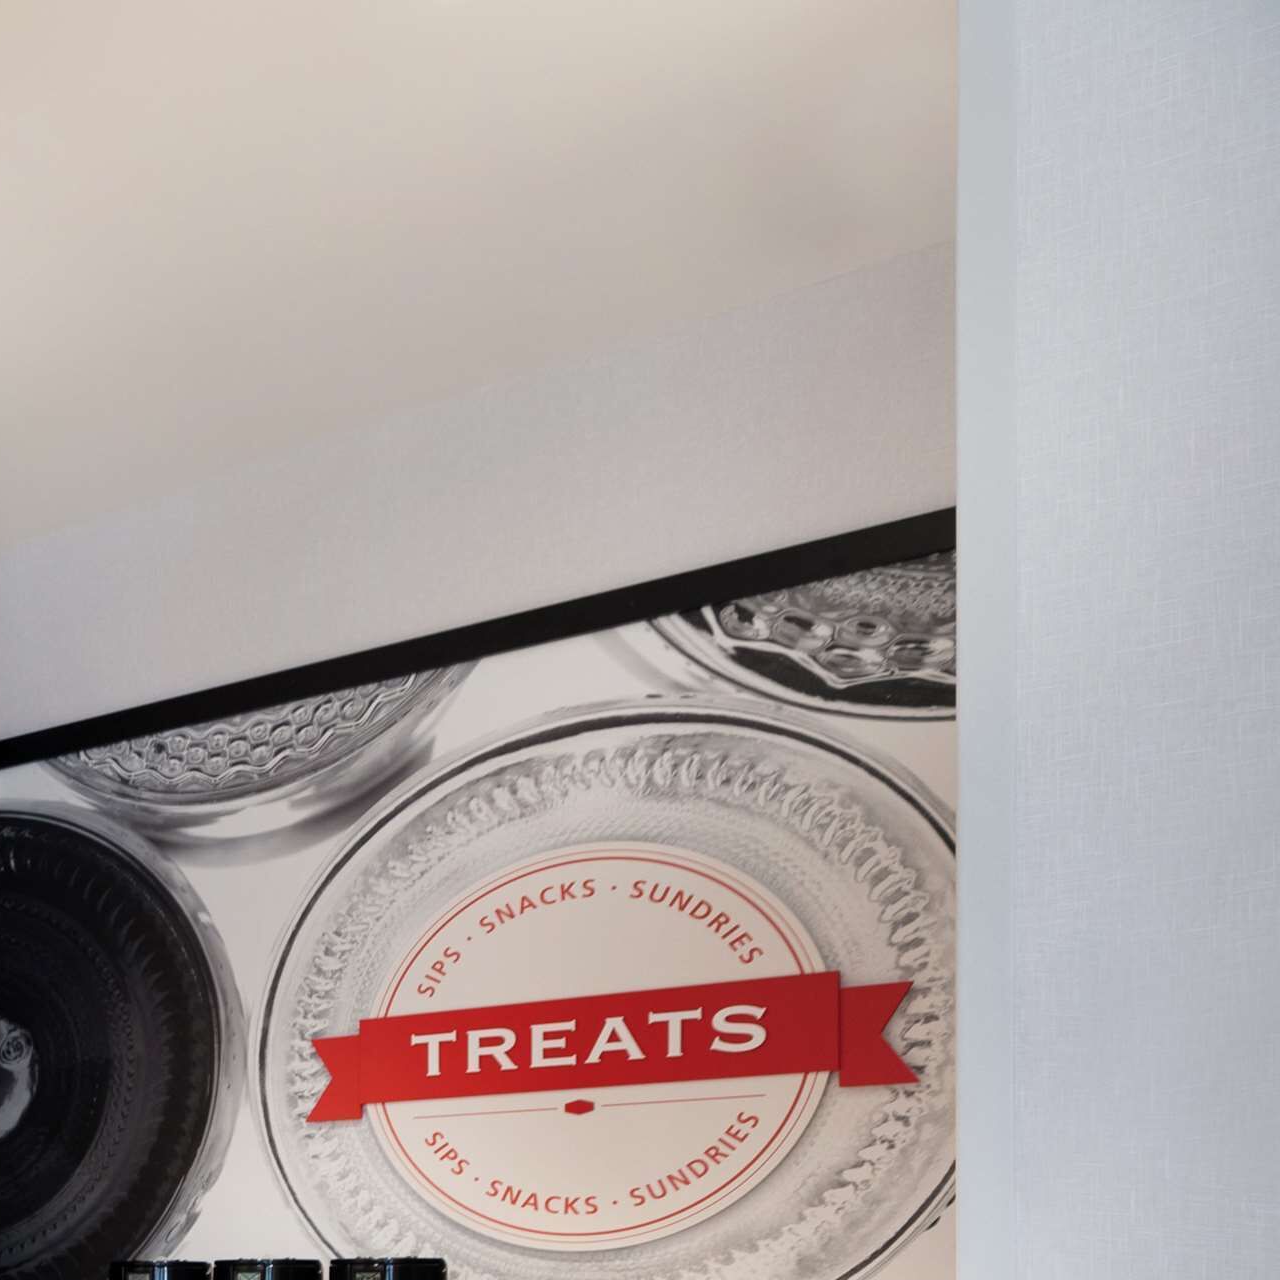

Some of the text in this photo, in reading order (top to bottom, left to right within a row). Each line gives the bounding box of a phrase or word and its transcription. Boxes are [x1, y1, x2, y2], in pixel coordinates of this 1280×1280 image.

[416, 878, 765, 999] SIPS SNACKS SUNDRIES
[409, 1003, 769, 1078] TREATS
[424, 1110, 760, 1216] SIPS SNACKS SUNDRIES
